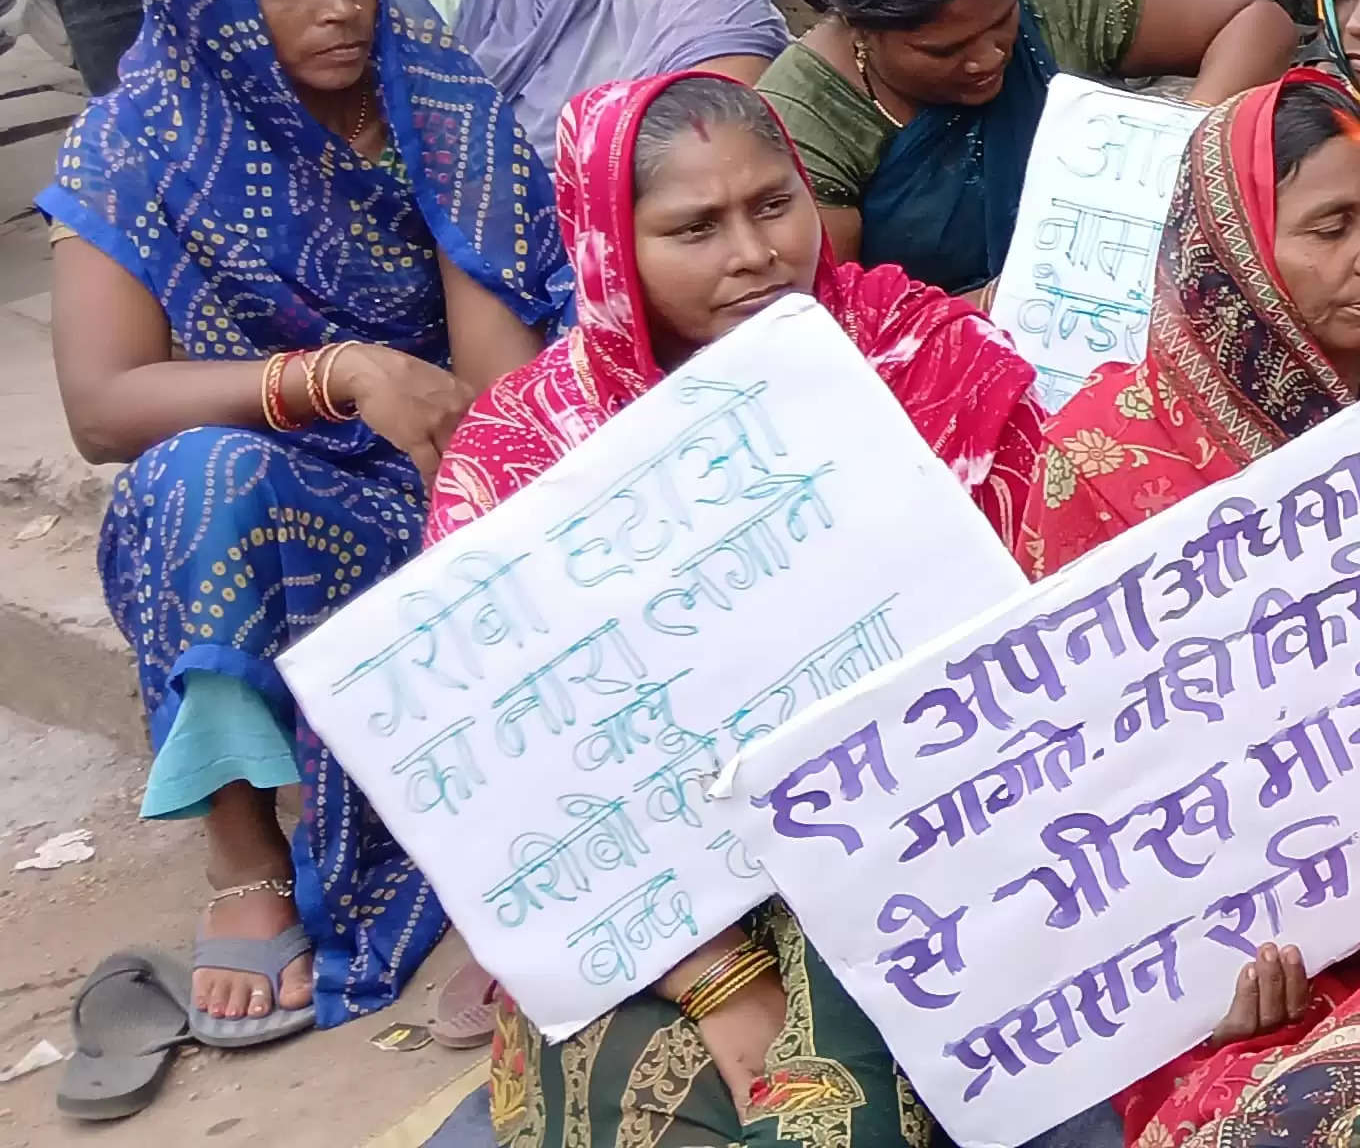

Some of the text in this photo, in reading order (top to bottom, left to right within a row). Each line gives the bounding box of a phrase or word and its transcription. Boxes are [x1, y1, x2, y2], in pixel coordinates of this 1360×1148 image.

[391, 717, 487, 815] का
[751, 720, 900, 856] हम
[903, 552, 1161, 757] अपना
[1113, 635, 1238, 744] नही
[876, 894, 970, 1010] से
[992, 760, 1236, 931] भीख
